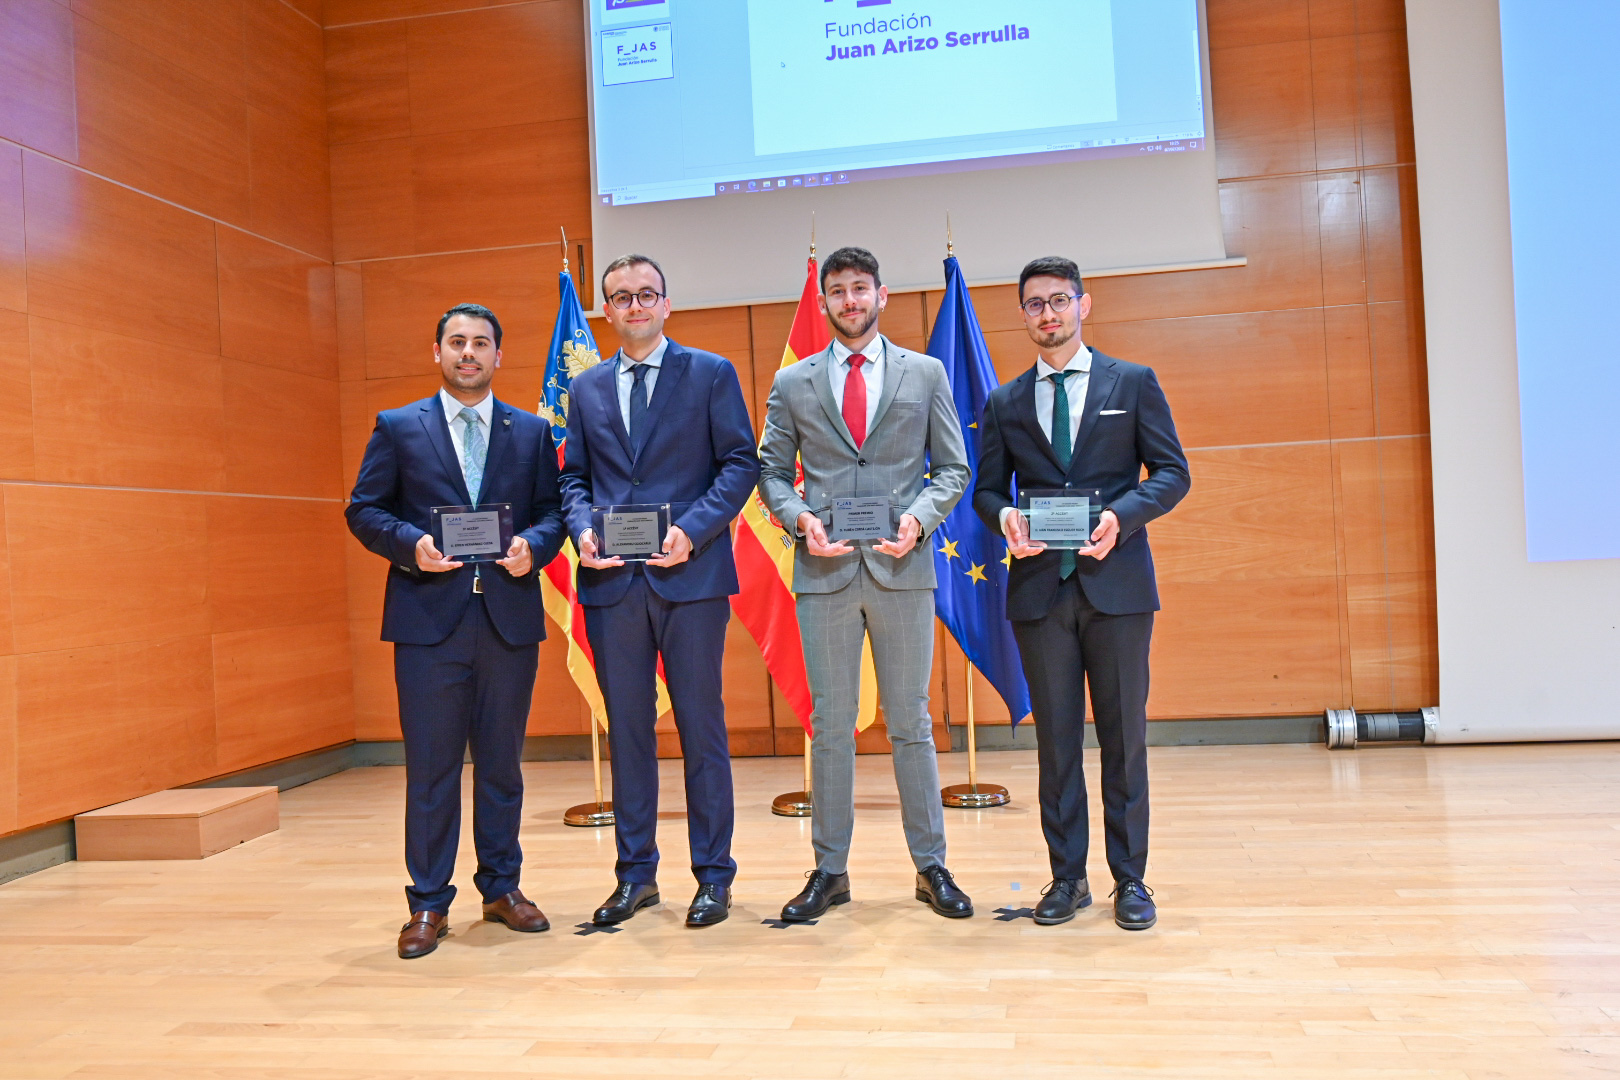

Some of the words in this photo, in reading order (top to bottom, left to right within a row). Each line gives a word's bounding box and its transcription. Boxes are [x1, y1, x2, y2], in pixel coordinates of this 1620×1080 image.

[825, 13, 932, 39] Fundación
[617, 41, 657, 56] F_JAS
[825, 43, 876, 61] Juan
[882, 36, 939, 55] Arizo
[945, 24, 1030, 48] Serrulla
